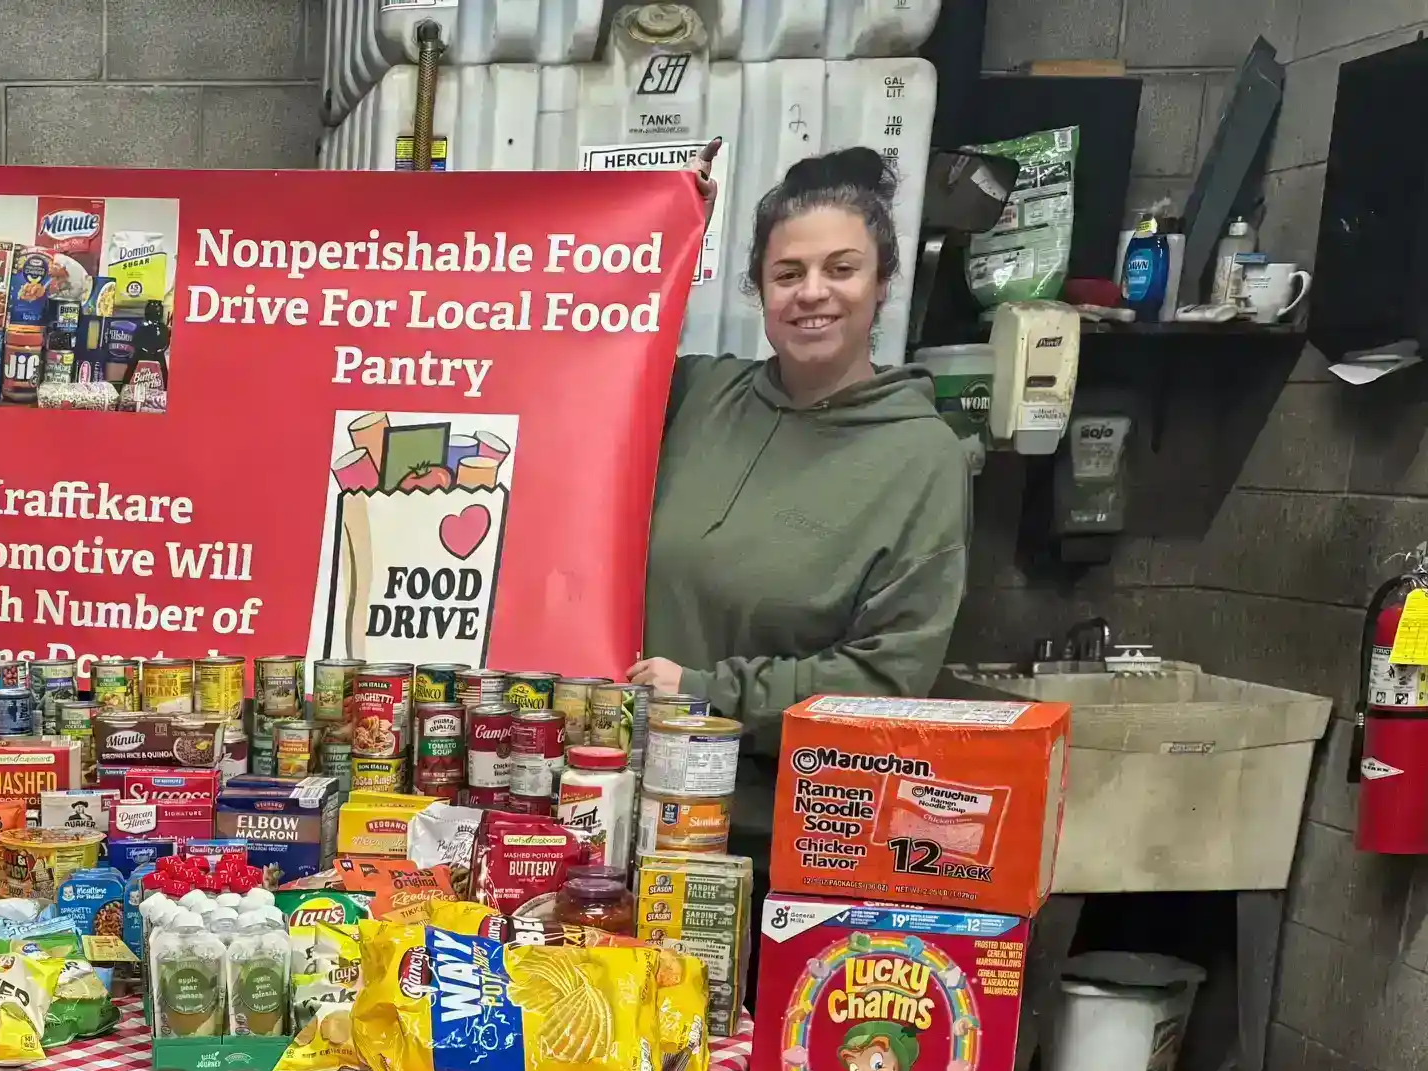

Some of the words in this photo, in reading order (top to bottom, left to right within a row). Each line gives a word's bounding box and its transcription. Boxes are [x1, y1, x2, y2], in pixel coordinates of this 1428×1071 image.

[884, 76, 905, 86] GAL
[640, 114, 681, 125] TANKS
[884, 126, 901, 136] 416
[39, 213, 99, 234] Minute
[119, 244, 155, 259] Domino
[194, 228, 533, 279] Nonperishable
[543, 232, 662, 275] Food
[185, 284, 308, 326] Drive
[319, 289, 397, 329] For
[406, 291, 532, 332] Local
[542, 292, 660, 333] Food
[5, 355, 39, 380] Jif
[332, 346, 493, 398] Pantry
[165, 541, 253, 581] Will
[385, 565, 483, 603] FOOD
[33, 589, 204, 633] Number
[212, 597, 263, 635] of
[366, 604, 479, 641] DRIVE
[355, 693, 394, 703] SPAGHETTI
[106, 732, 145, 749] Minute
[818, 747, 931, 777] Maruchan
[797, 779, 873, 801] Ramen
[119, 808, 154, 822] Duncan
[794, 797, 874, 818] Noodle
[238, 815, 300, 830] ELBOW
[804, 815, 861, 837] Soup
[236, 830, 298, 840] MACARONI
[509, 861, 557, 876] BUTTERY
[801, 854, 858, 870] Flavor
[889, 837, 942, 875] 12
[943, 865, 994, 881] PACK
[393, 877, 439, 889] Original
[974, 941, 998, 950] FROSTED
[401, 947, 427, 999] Clancy's
[976, 957, 1022, 968] MARSHMALLOWS
[846, 958, 931, 998] Lucky
[828, 989, 935, 1030] Charms
[197, 1059, 221, 1068] JOURNEY
